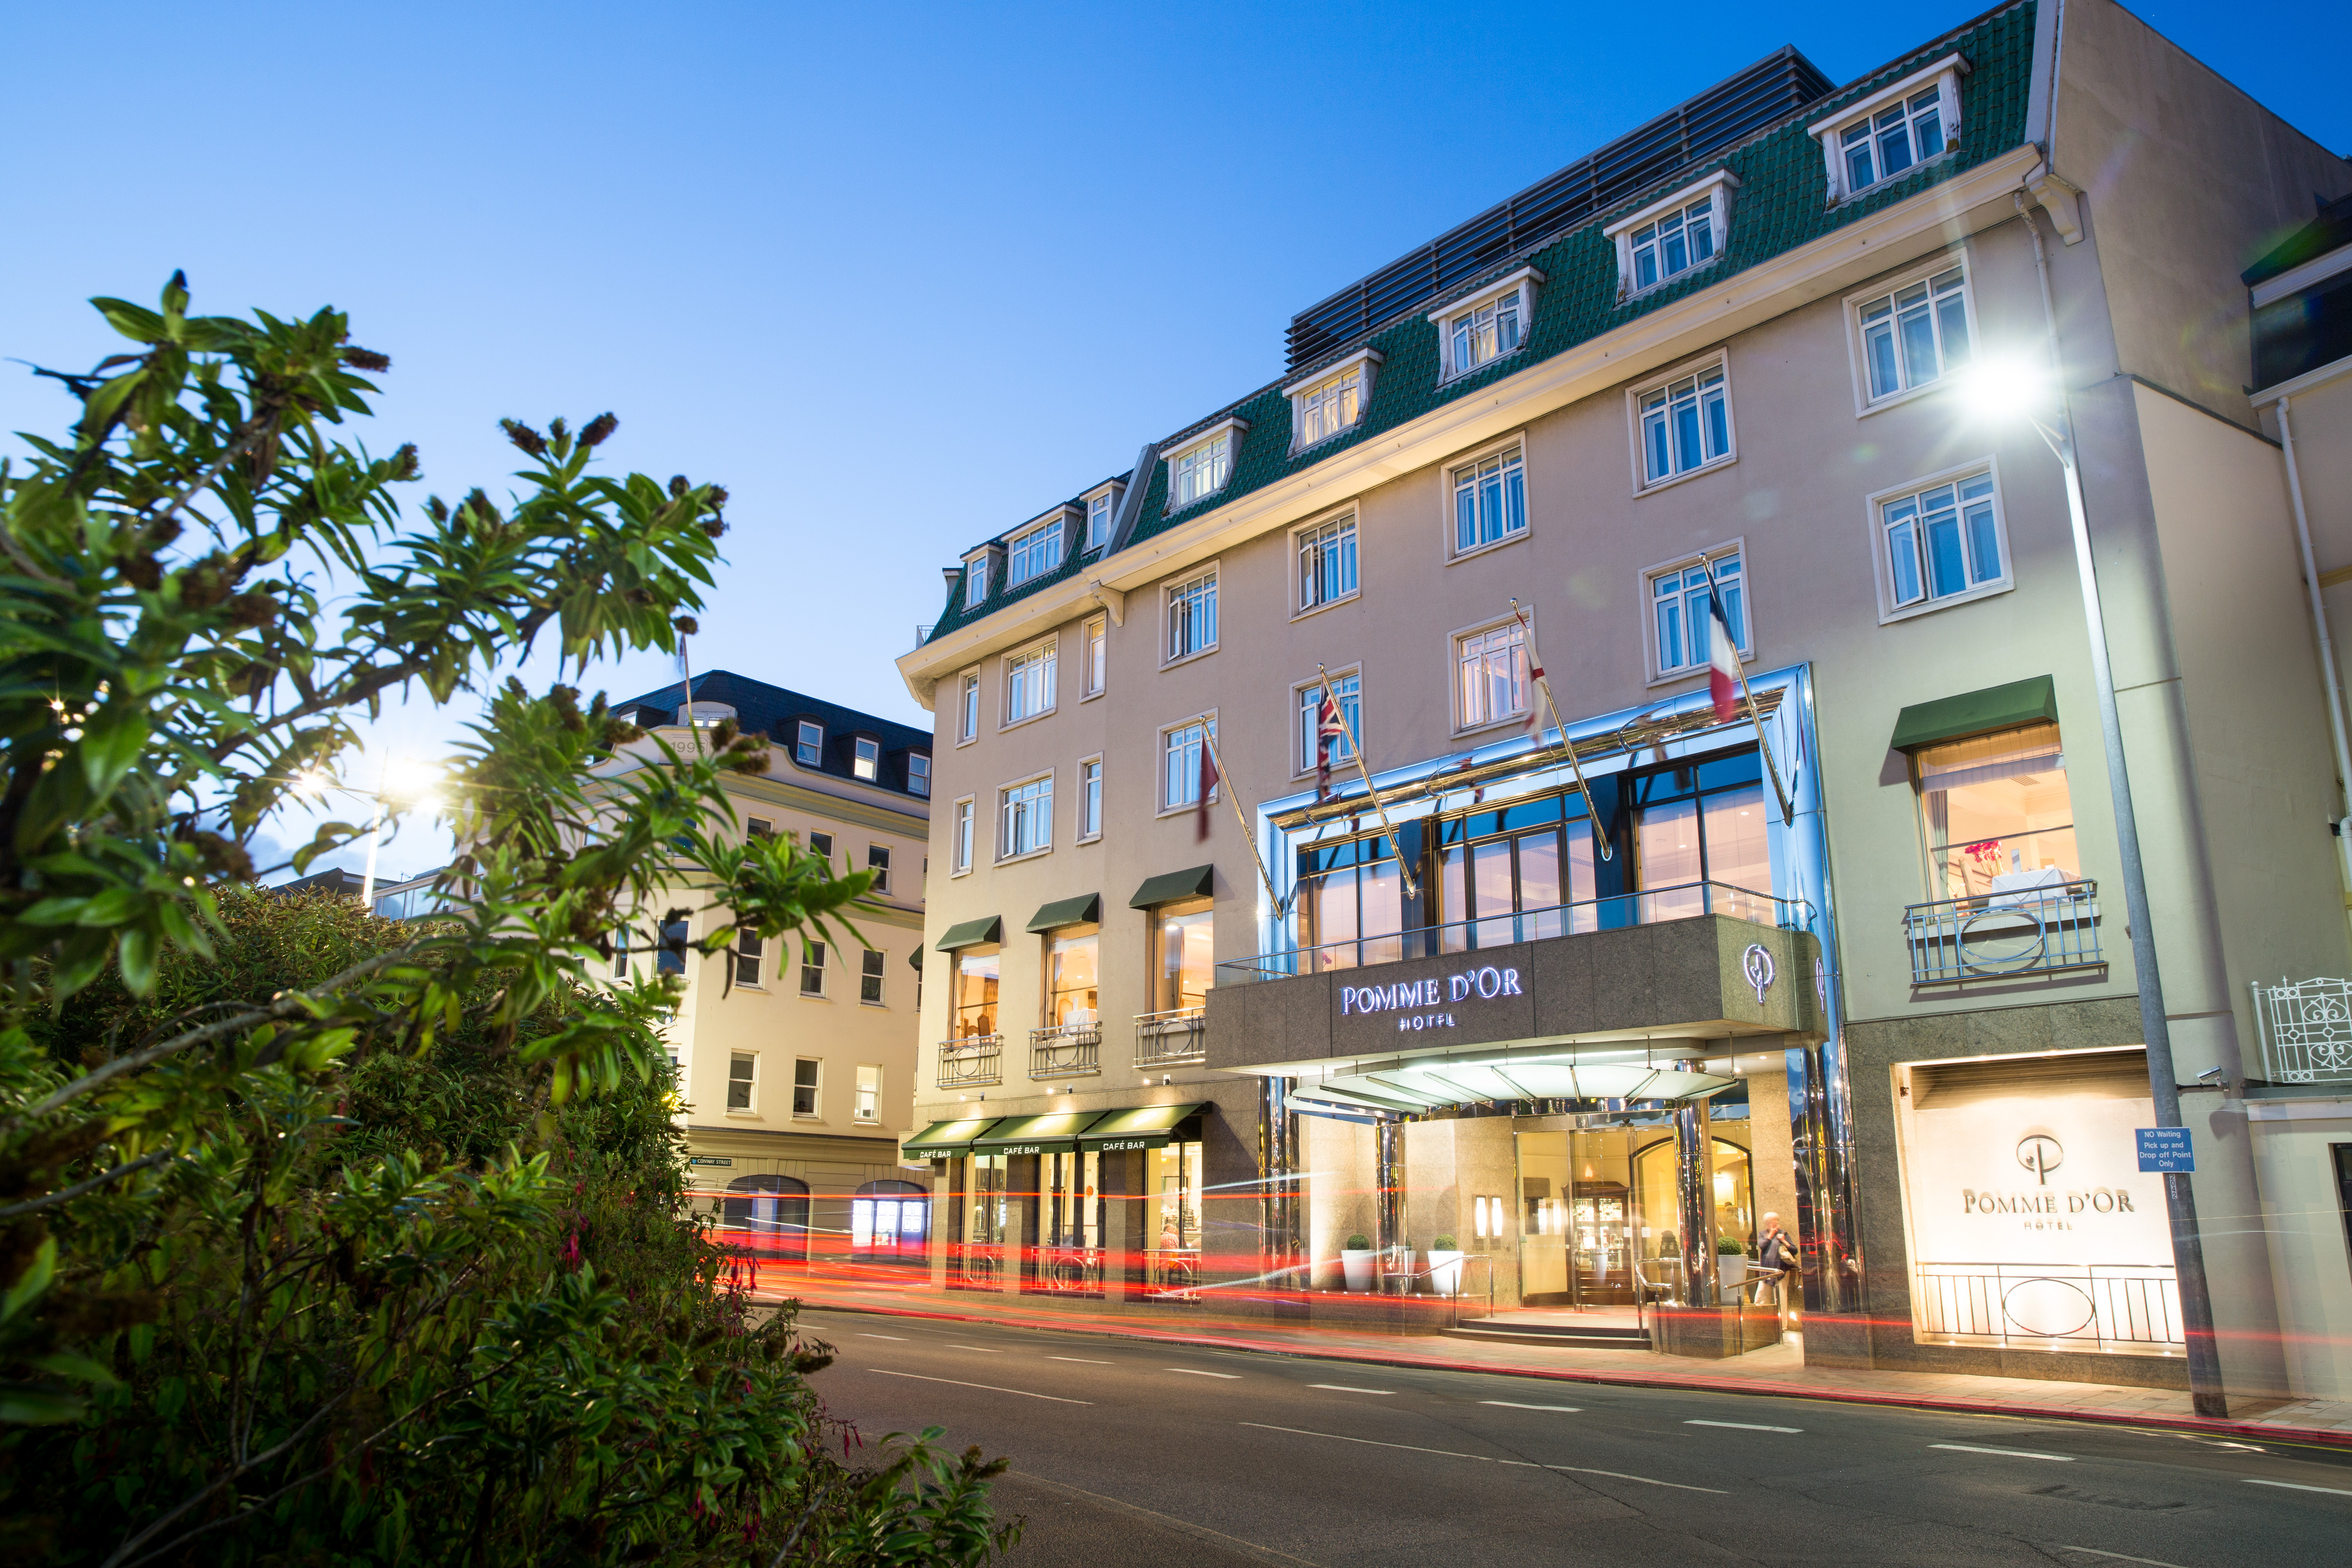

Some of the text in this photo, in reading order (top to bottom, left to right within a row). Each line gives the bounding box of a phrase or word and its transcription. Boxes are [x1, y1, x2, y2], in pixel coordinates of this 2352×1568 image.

[1338, 979, 1440, 1015] POMME
[1398, 1013, 1455, 1031] HOTEL
[1004, 1145, 1022, 1154] CAFÉ
[1103, 1140, 1125, 1150] CAFÉ
[1963, 1193, 2058, 1213] POMME
[2024, 1222, 2073, 1230] HOTEL
